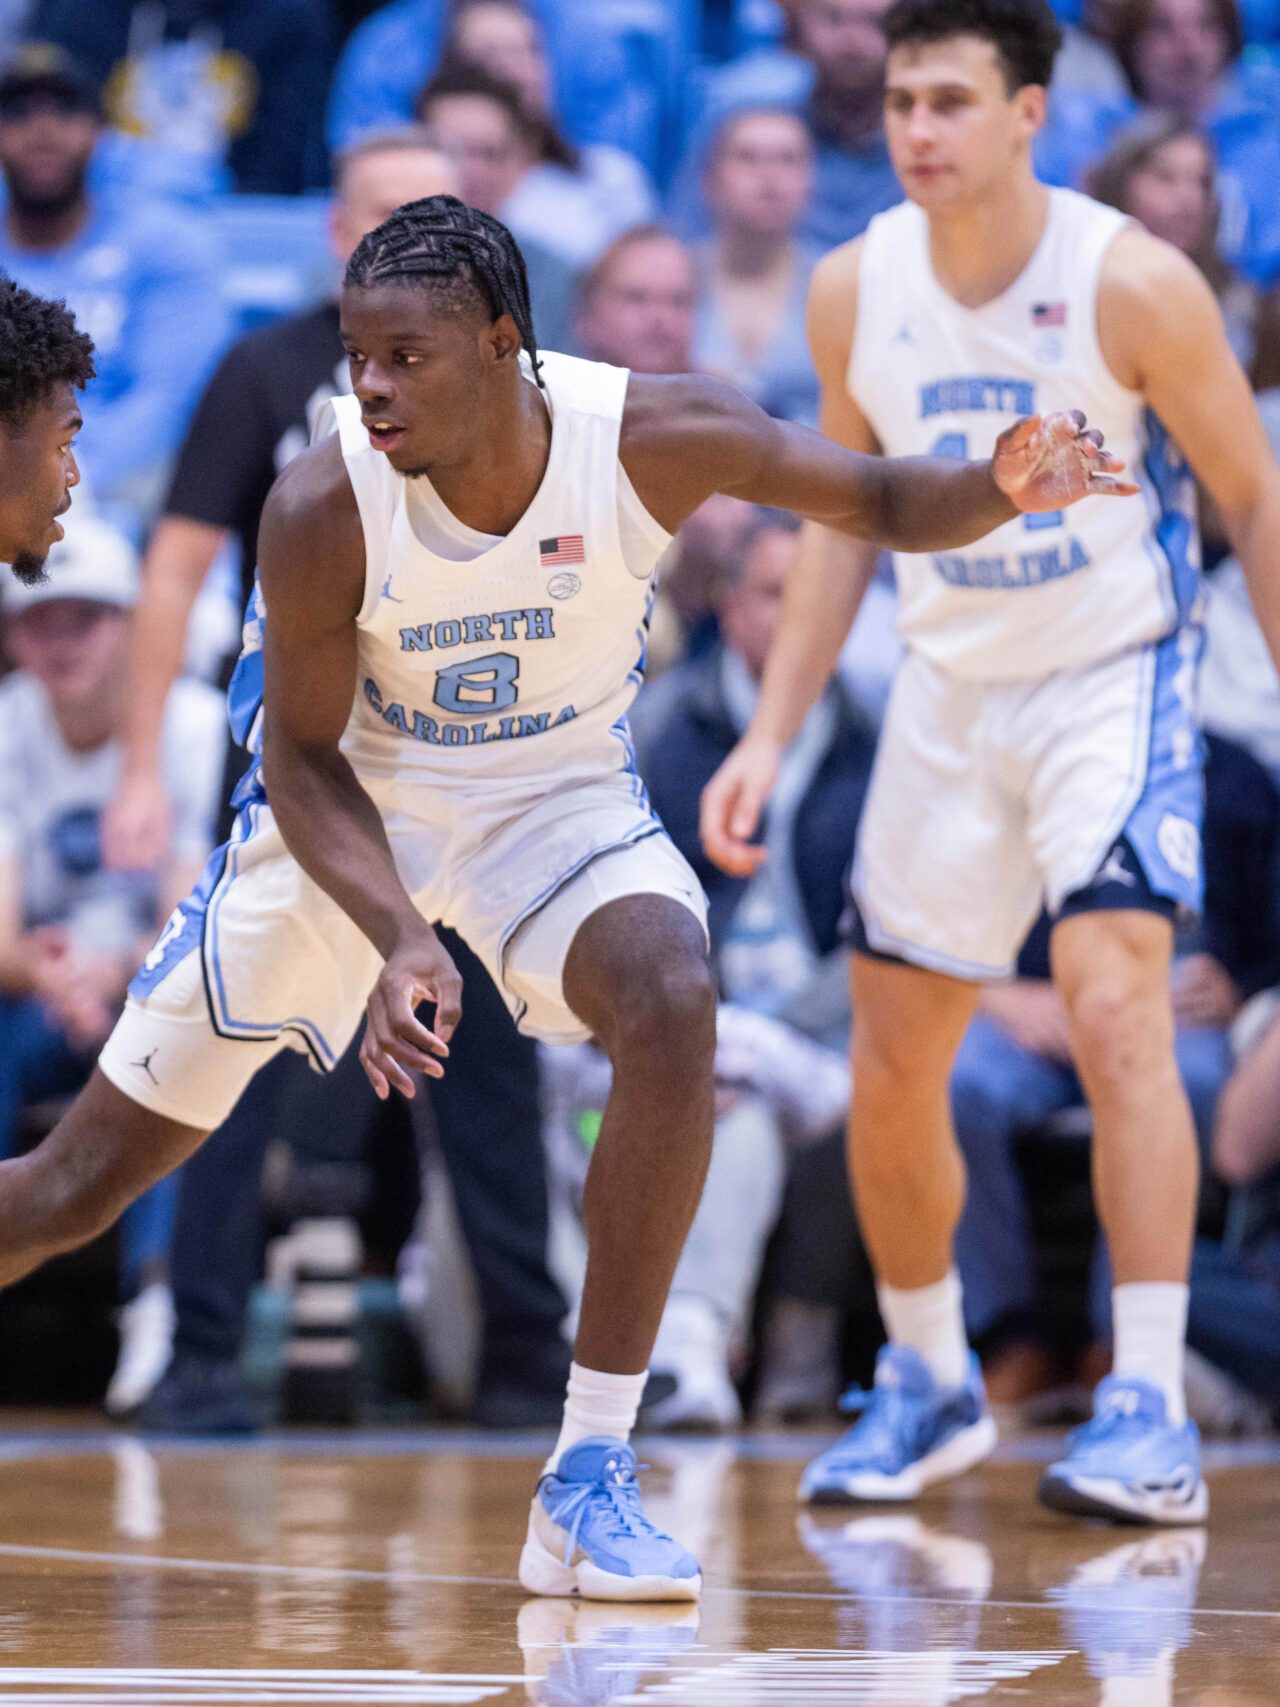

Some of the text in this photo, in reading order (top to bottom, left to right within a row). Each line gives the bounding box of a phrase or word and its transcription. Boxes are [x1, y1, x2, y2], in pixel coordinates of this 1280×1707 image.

[399, 607, 555, 651] NORTH
[364, 677, 578, 746] CAROLINA
[433, 652, 520, 714] 8
